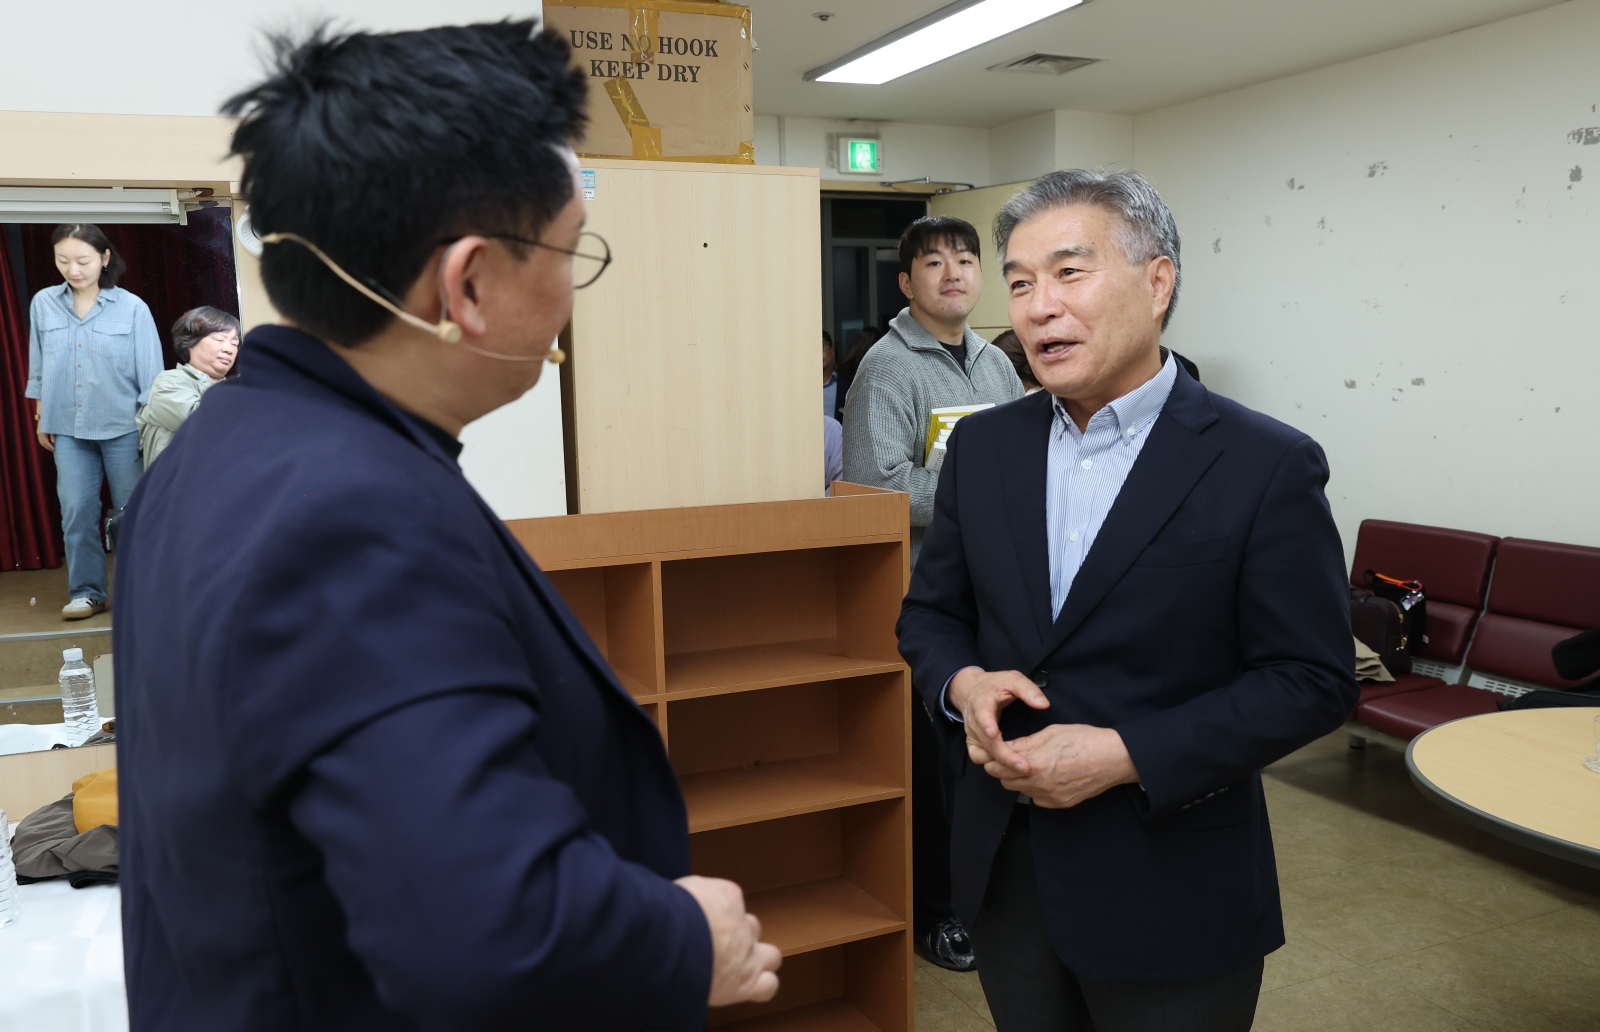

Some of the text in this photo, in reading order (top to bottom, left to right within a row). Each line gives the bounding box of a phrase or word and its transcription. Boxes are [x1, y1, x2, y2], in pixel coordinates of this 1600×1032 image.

[570, 29, 719, 58] USE NO HOOK
[589, 59, 701, 83] KEEP DRY
